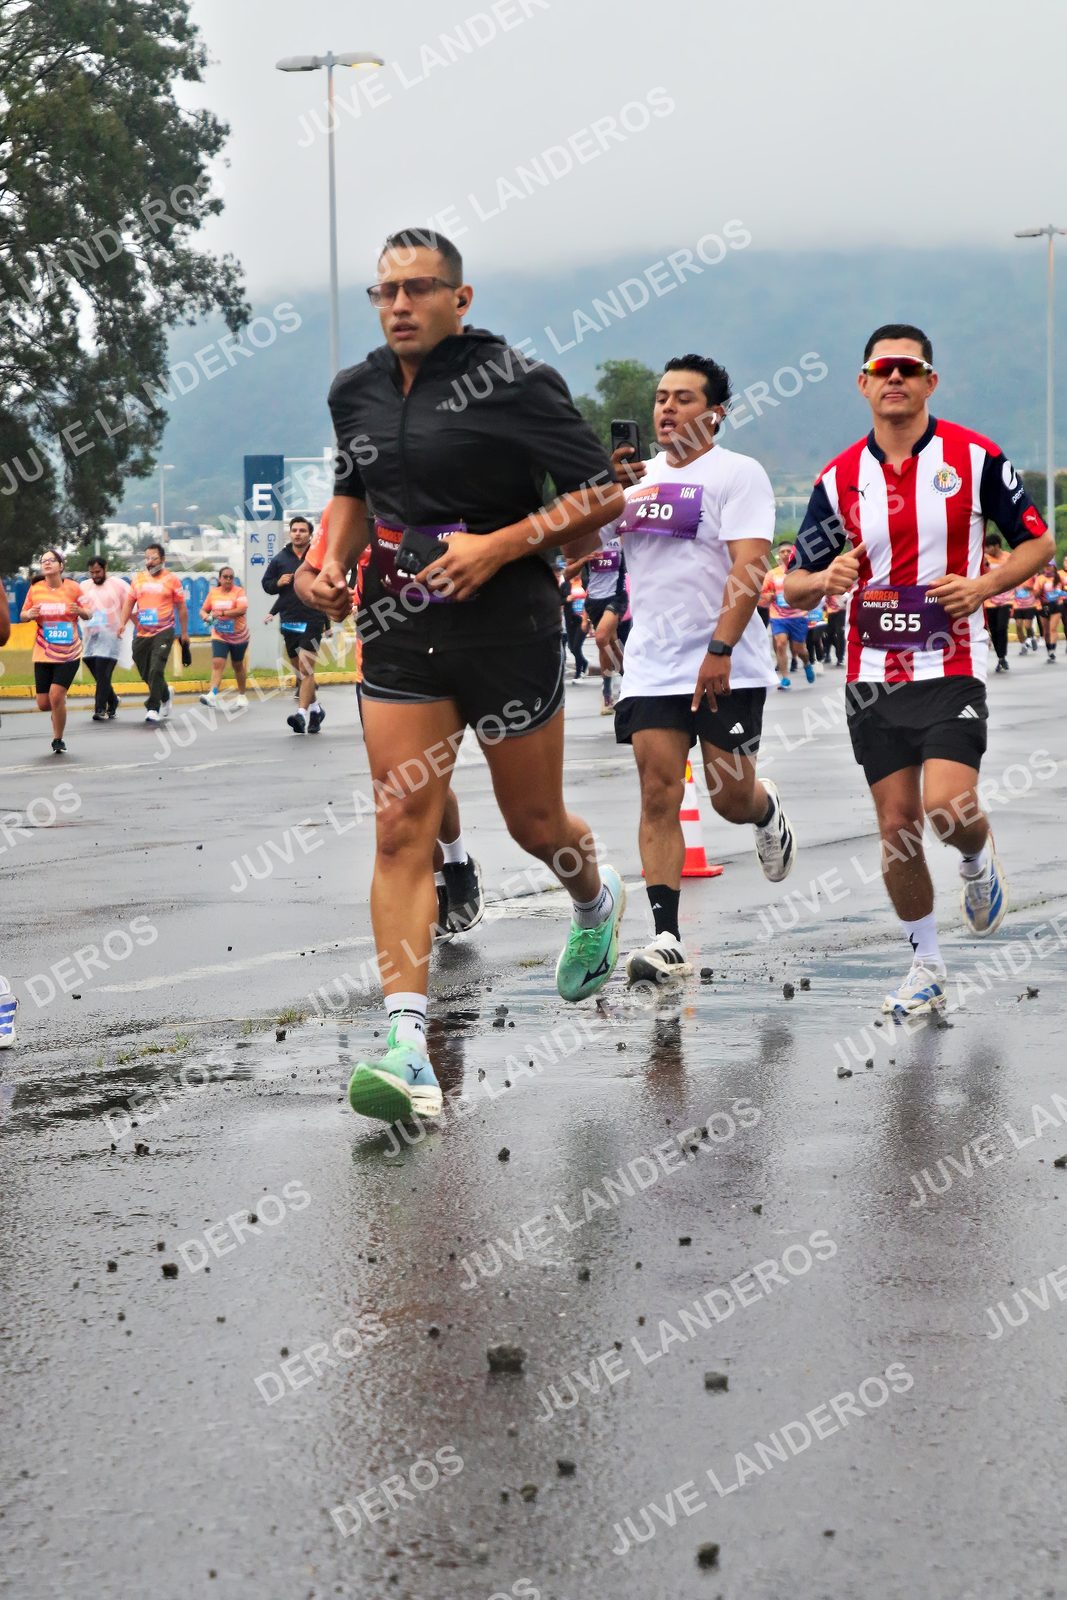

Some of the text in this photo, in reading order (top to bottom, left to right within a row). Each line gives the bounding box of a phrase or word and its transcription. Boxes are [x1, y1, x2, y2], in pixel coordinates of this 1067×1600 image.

[252, 484, 272, 511] E
[636, 503, 673, 520] 430
[864, 590, 898, 600] CARRERA
[880, 613, 921, 632] 655
[48, 630, 68, 638] 2820
